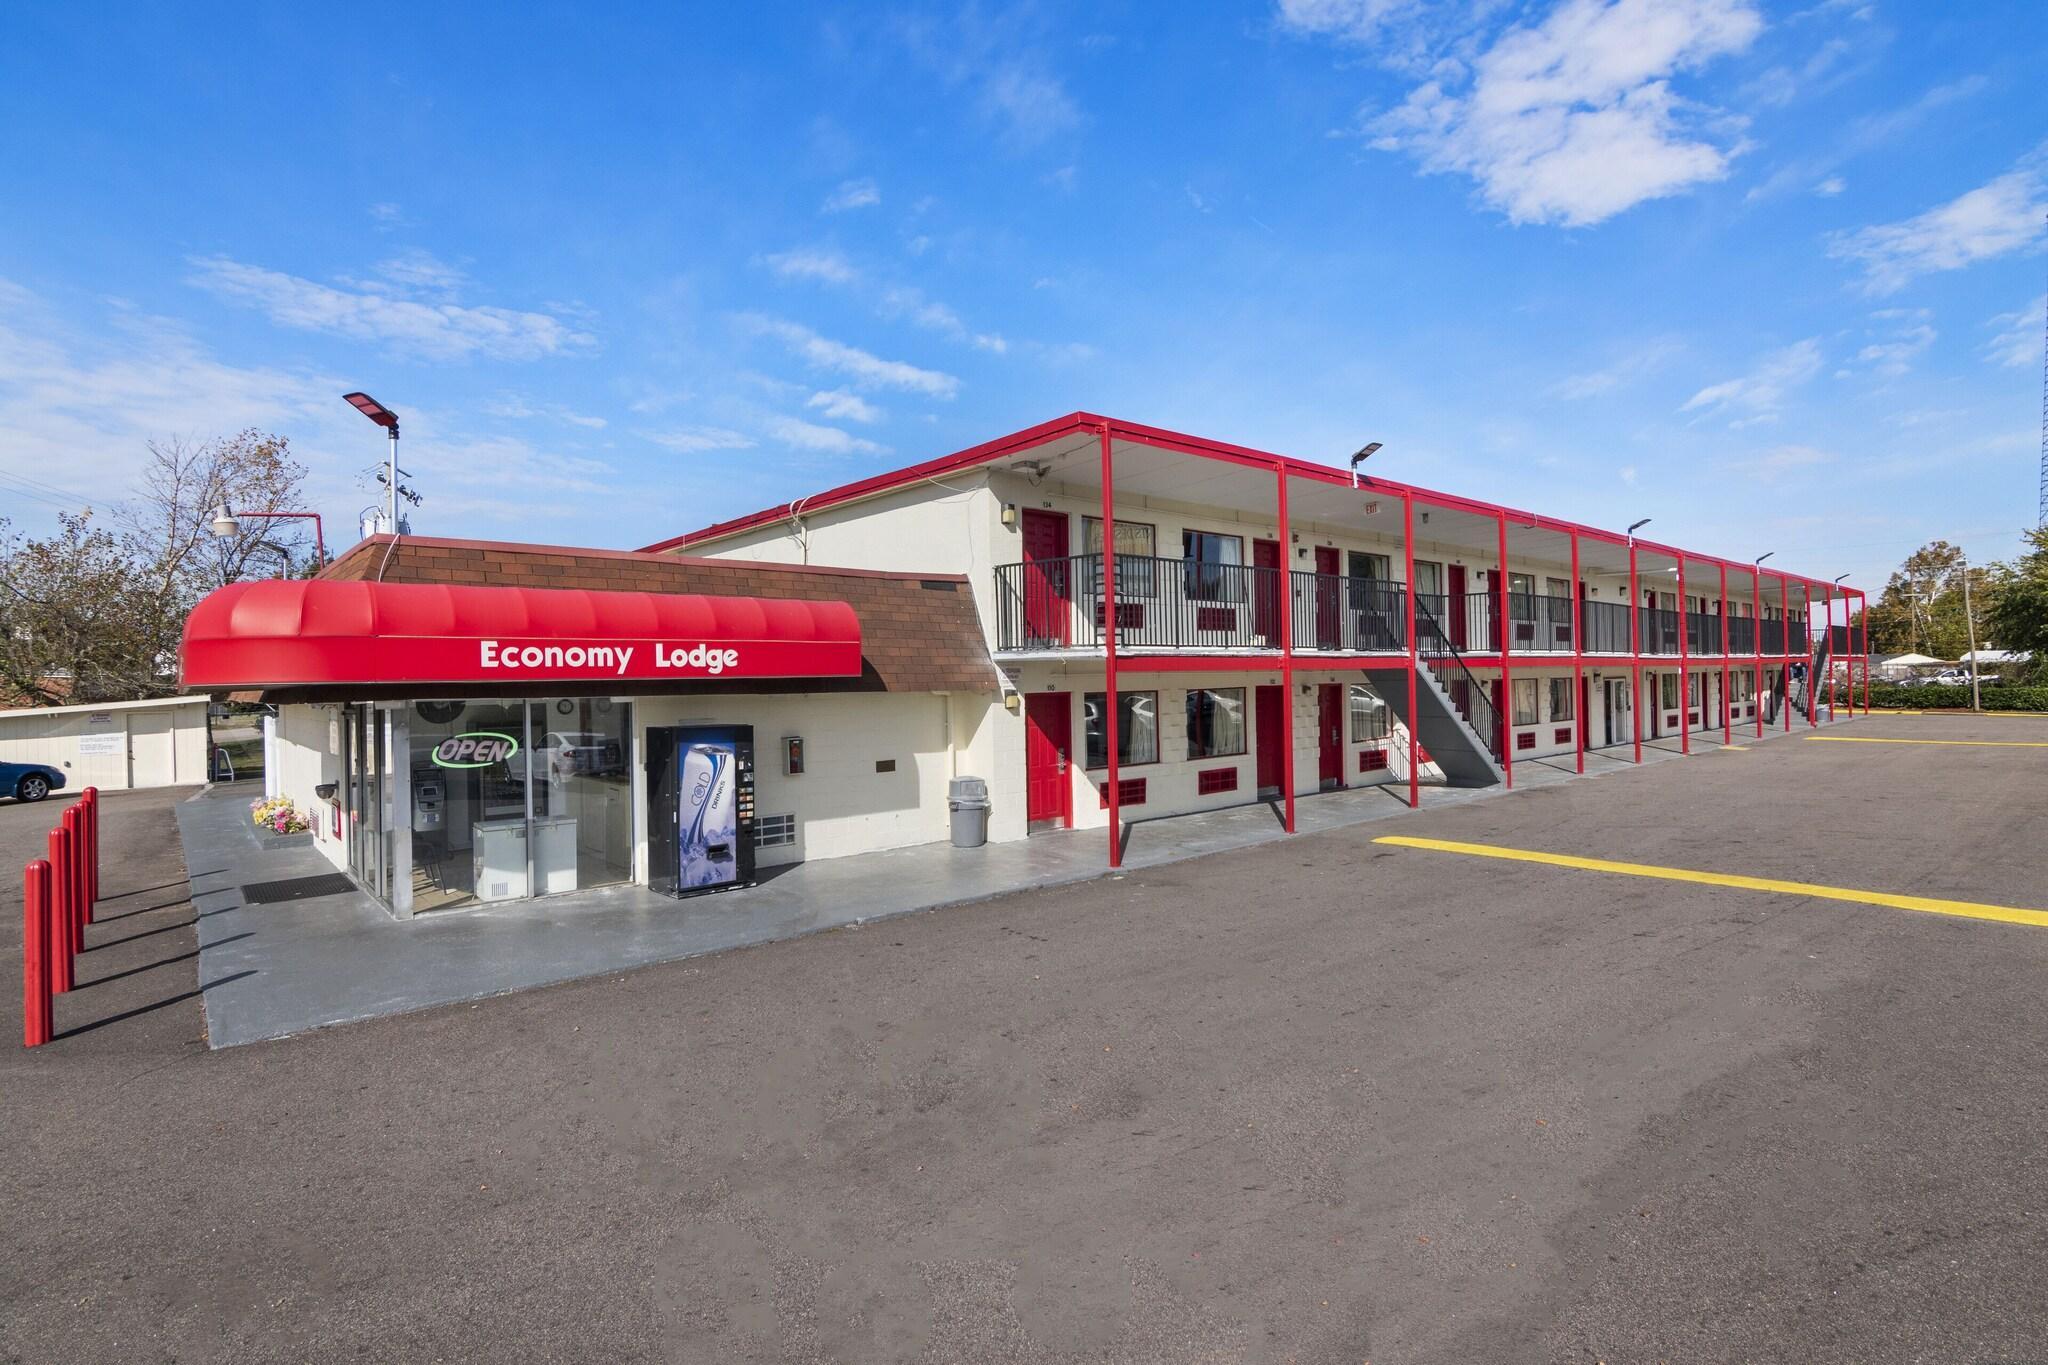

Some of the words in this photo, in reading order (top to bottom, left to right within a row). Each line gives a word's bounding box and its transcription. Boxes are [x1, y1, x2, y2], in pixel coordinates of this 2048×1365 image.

[480, 640, 635, 675] Economy
[655, 643, 739, 674] Lodge
[438, 738, 510, 762] OPEN
[691, 771, 711, 807] COLD
[711, 780, 726, 810] DRINKS
